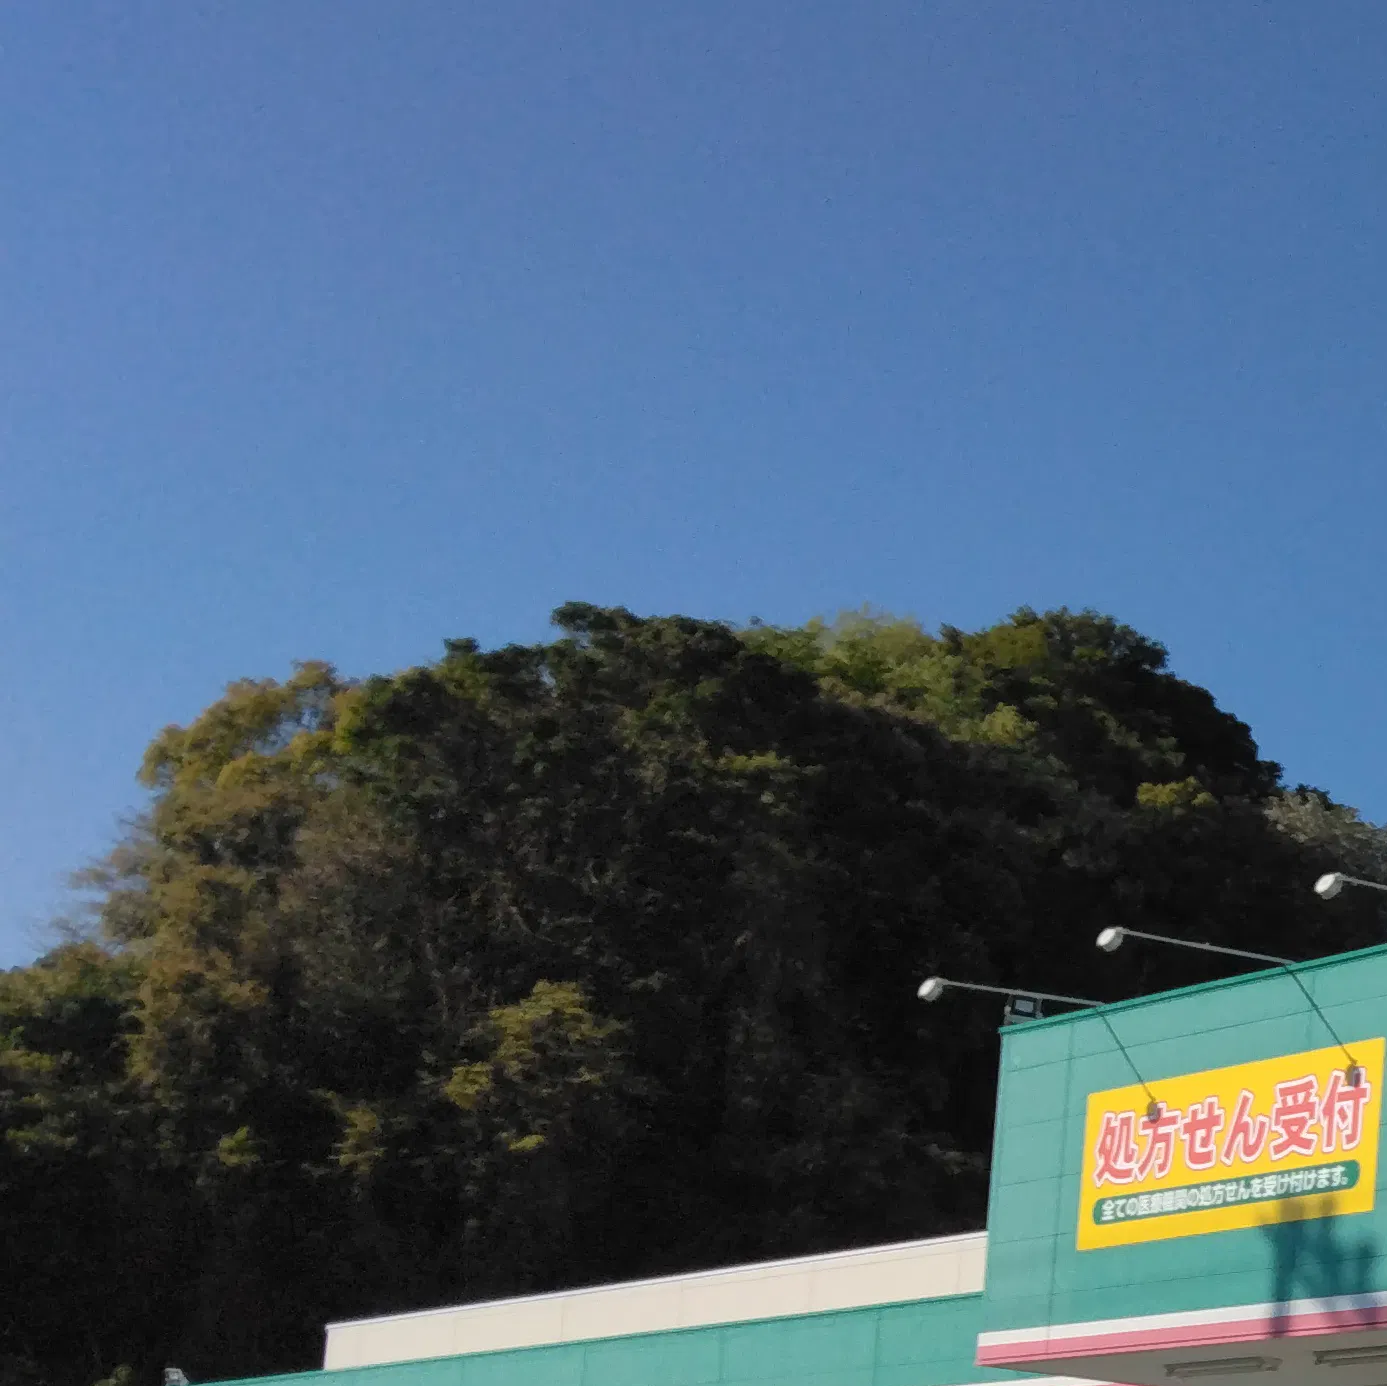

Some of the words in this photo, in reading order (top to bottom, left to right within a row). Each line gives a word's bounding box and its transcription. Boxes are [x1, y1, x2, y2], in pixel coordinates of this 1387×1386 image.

[1095, 1064, 1371, 1189] 処方せん受付
